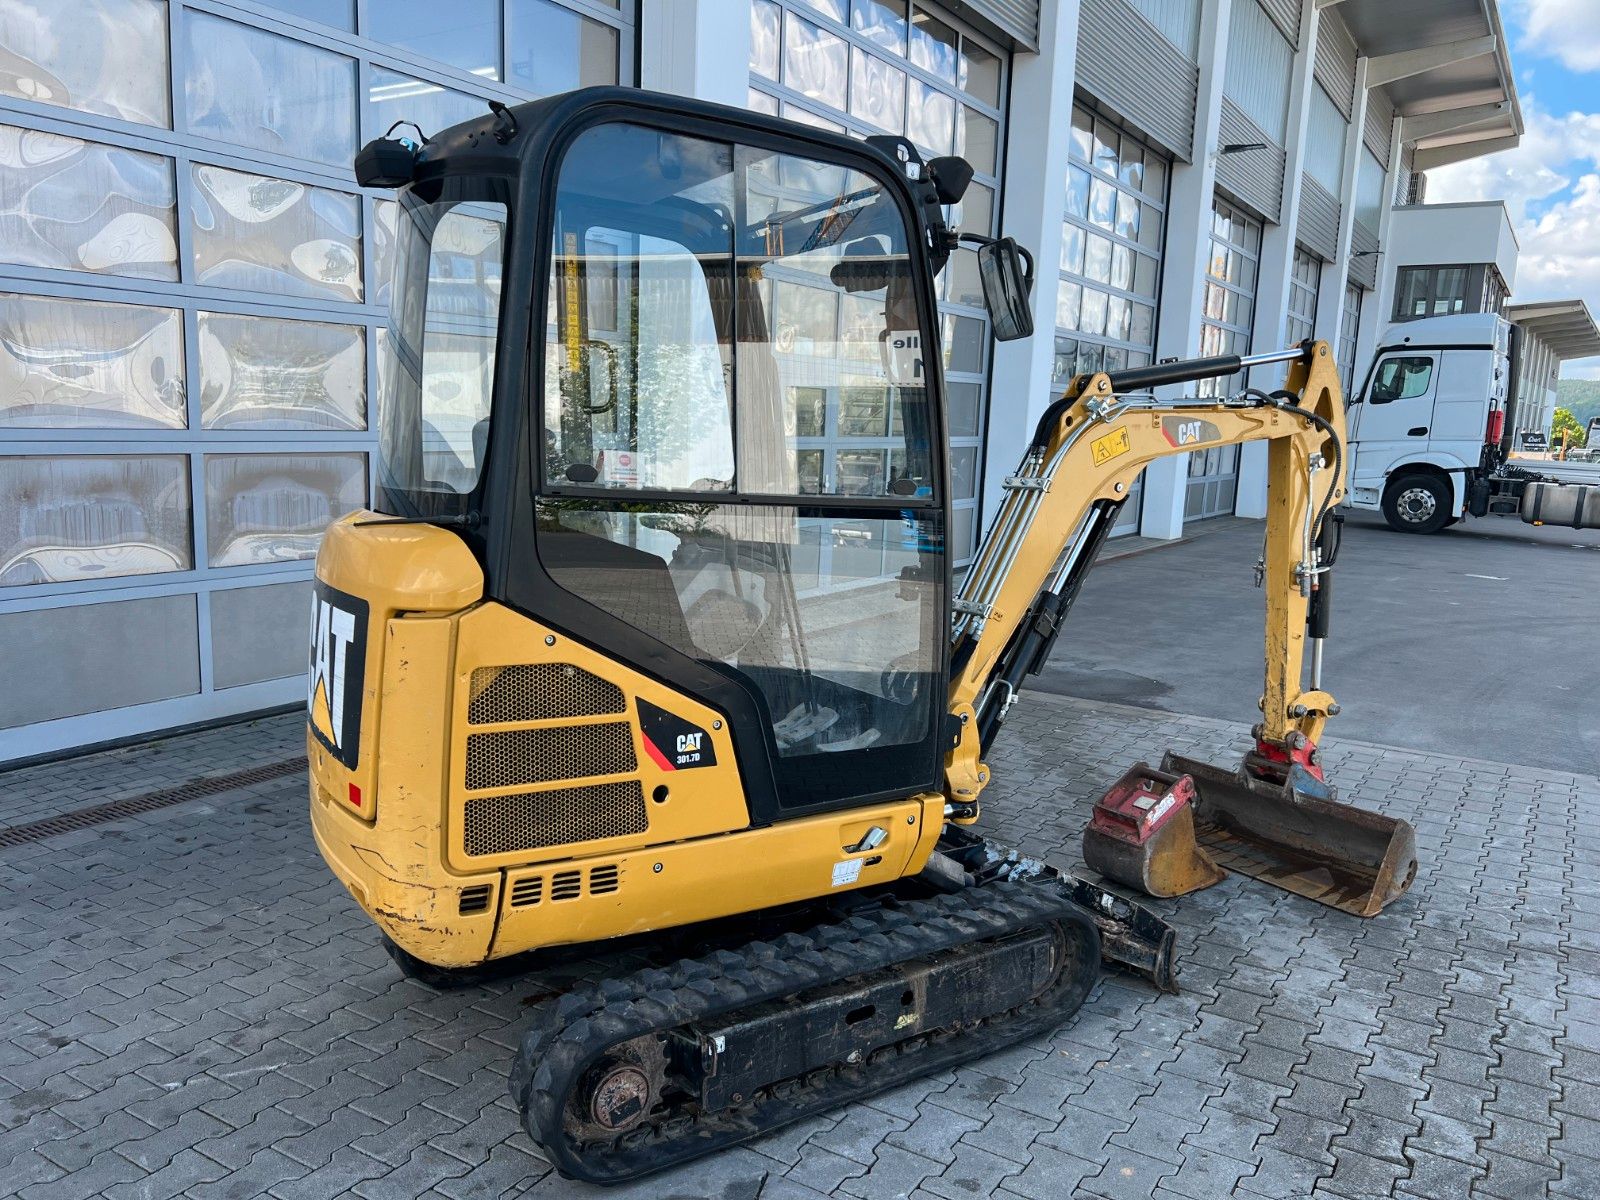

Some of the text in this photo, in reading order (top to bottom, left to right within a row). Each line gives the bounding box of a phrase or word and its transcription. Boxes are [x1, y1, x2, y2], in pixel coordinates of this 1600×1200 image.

[1178, 421, 1201, 445] CAT
[308, 589, 355, 750] CAT
[676, 732, 703, 752] CAT
[676, 753, 701, 764] 301.7D
